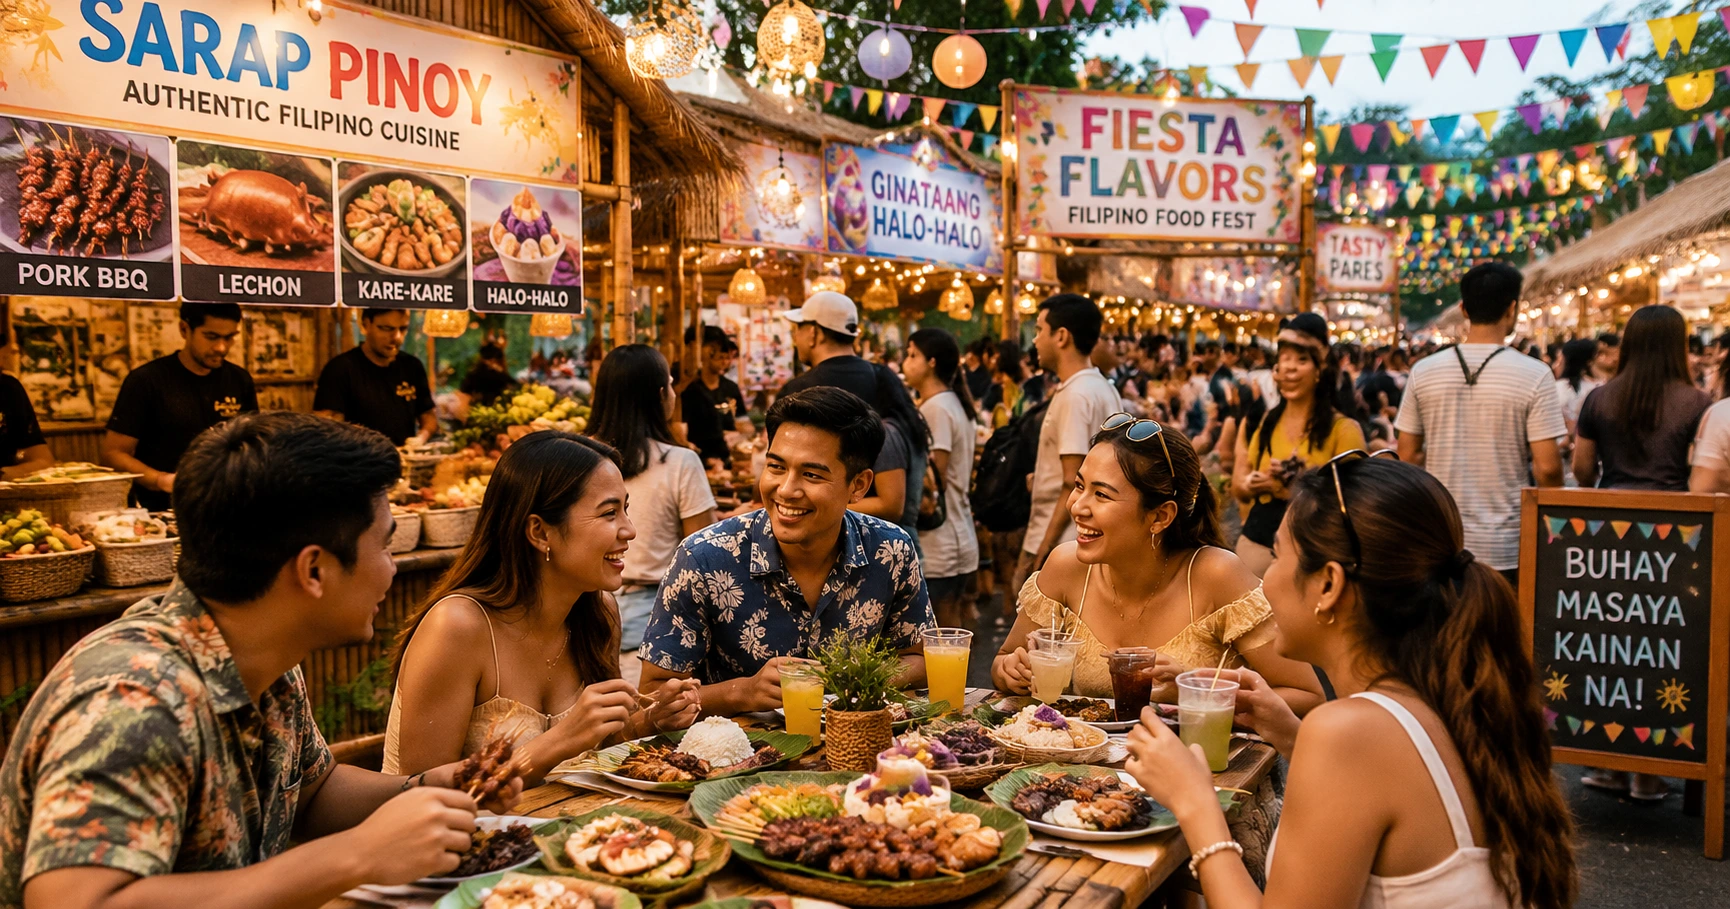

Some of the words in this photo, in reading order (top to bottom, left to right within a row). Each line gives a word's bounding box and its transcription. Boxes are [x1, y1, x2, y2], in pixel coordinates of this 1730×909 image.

[79, 0, 311, 91] SARAP
[329, 41, 492, 125] PINOY
[123, 80, 270, 122] AUTHENTIC
[280, 104, 374, 137] FILIPINO
[381, 120, 460, 151] CUISINE
[1081, 107, 1246, 157] FIESTA
[871, 170, 981, 220] GINATAANG
[1060, 155, 1266, 204] FLAVORS
[873, 205, 982, 250] HALO-HALO
[1068, 206, 1148, 225] FILIPINO
[1156, 209, 1205, 226] FOOD
[1212, 211, 1257, 230] FEST
[1330, 234, 1386, 257] TASTY
[18, 263, 91, 287] PORK
[97, 266, 149, 291] BBQ
[218, 274, 301, 297] LECHON
[1330, 258, 1384, 281] PARES
[358, 280, 453, 302] KARE-KARE
[487, 287, 569, 307] HALO-HALO
[1565, 547, 1676, 583] BUHAY
[1556, 589, 1686, 626] MASAYA
[1554, 631, 1680, 670] KAINAN
[1585, 675, 1643, 710] NA!
